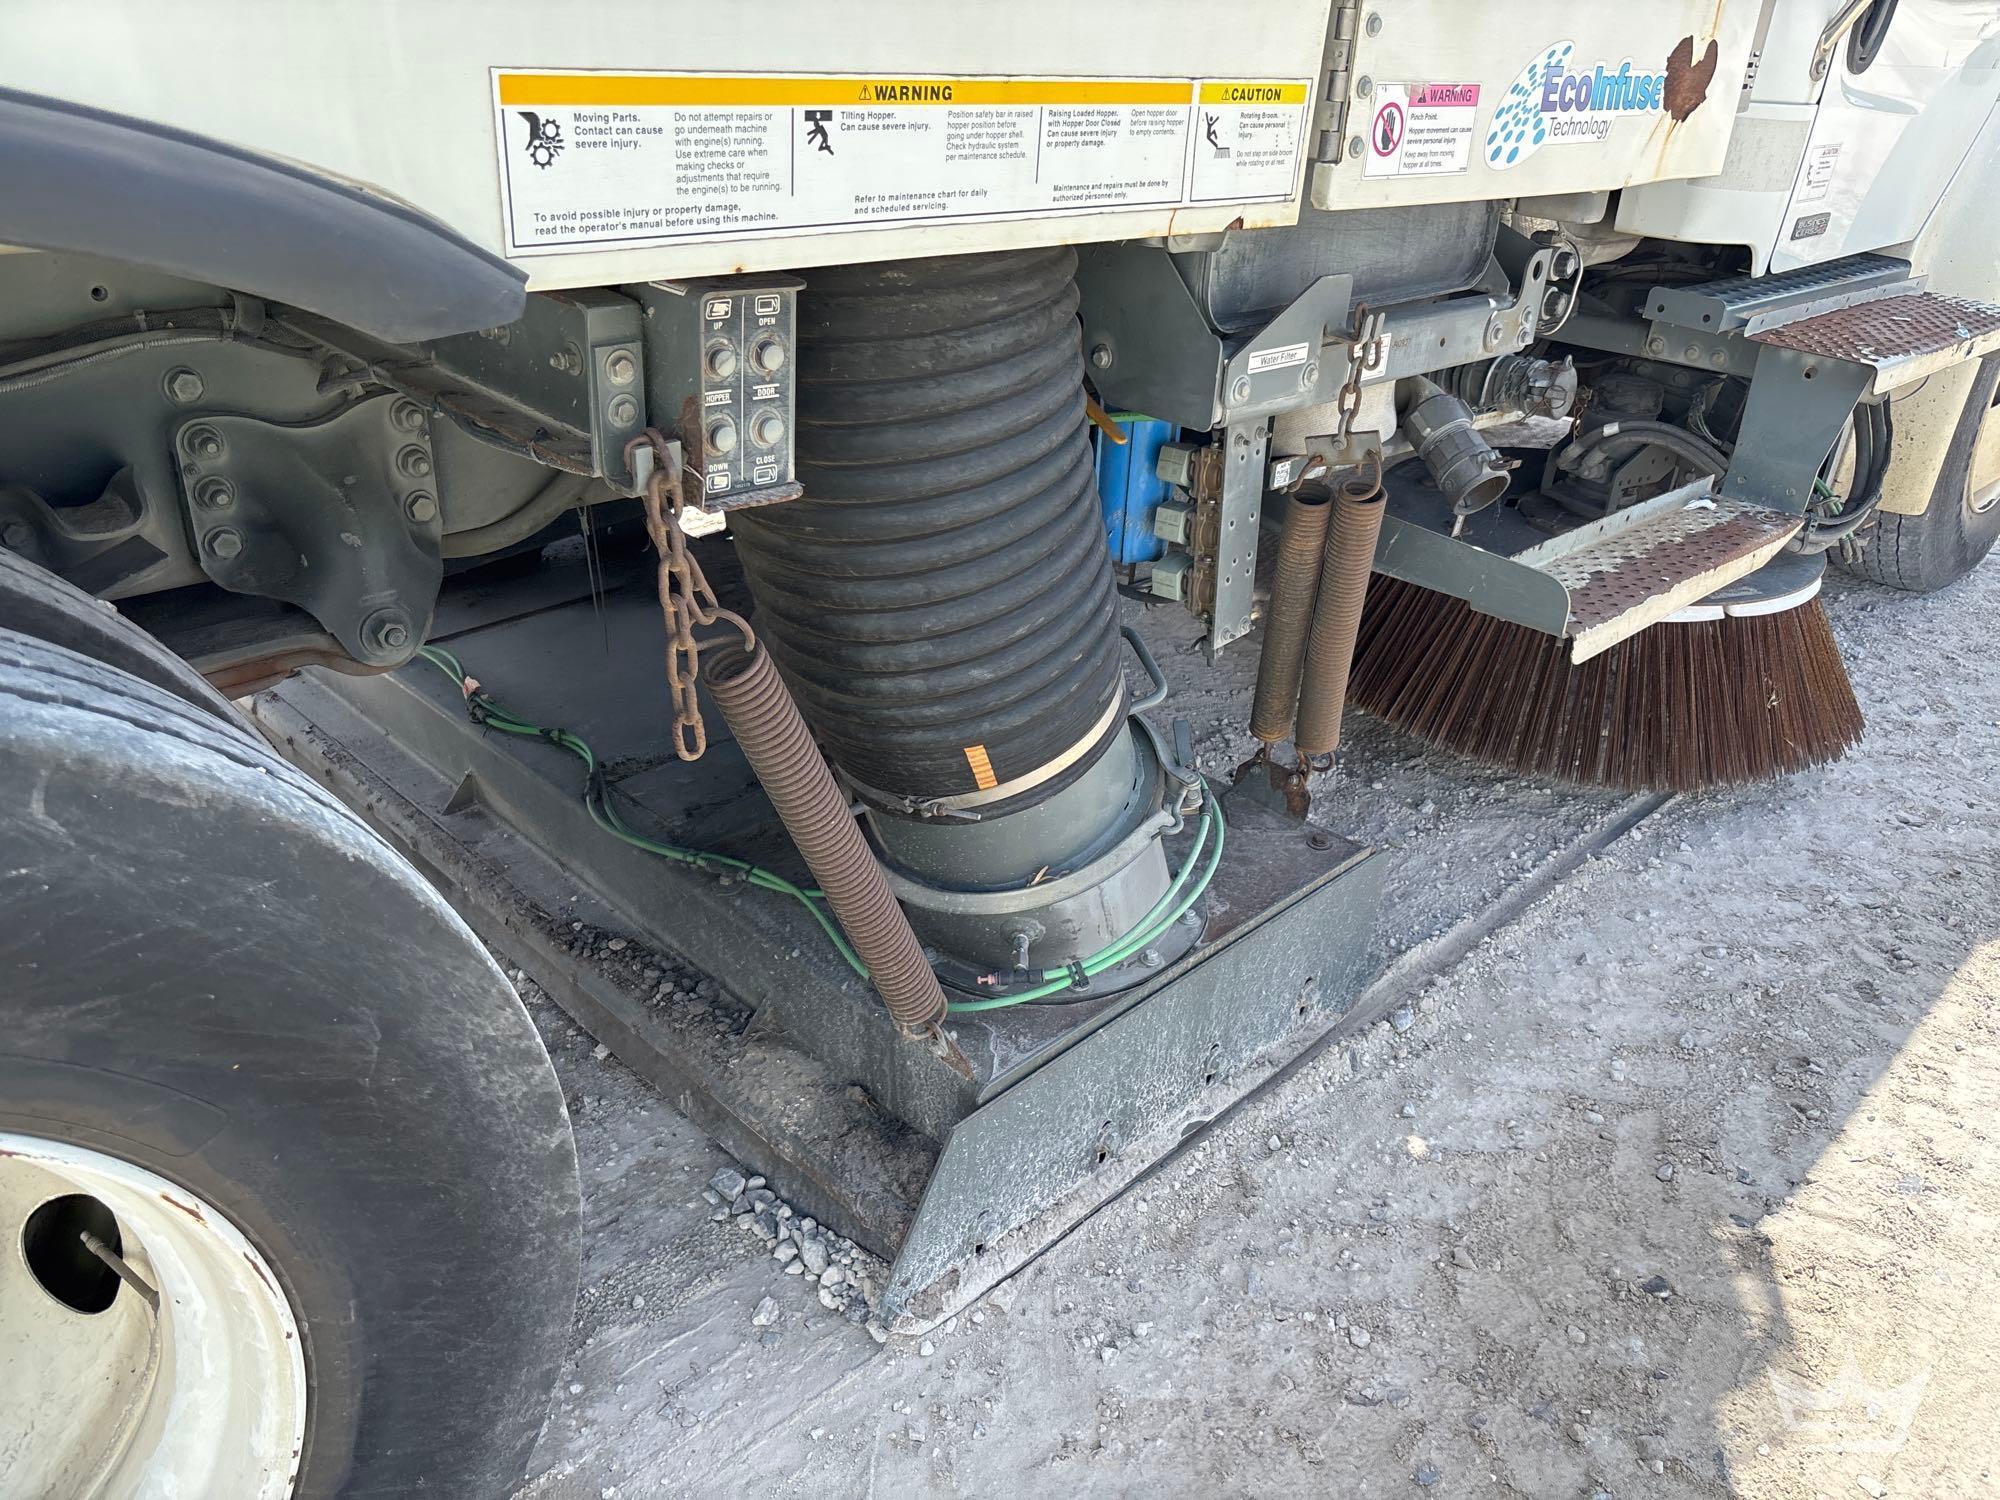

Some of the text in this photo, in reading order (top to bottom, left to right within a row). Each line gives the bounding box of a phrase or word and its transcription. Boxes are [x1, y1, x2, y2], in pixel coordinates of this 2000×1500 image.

[1540, 62, 1664, 112] EcoInfuse
[875, 86, 952, 100] WARNING
[1232, 88, 1281, 101] CAUTION
[1431, 89, 1472, 102] WARNING
[574, 113, 640, 124] Moving Parts.
[675, 113, 686, 122] Do
[689, 113, 701, 121] not
[704, 113, 733, 122] attempt
[736, 113, 762, 122] repairs
[841, 111, 896, 121] Tilting Hopper.
[975, 110, 994, 119] safety
[1049, 110, 1071, 118] Raising
[841, 123, 855, 131] Can
[908, 122, 931, 131] injury.
[947, 122, 969, 130] hopper
[971, 121, 995, 130] position
[1062, 120, 1084, 128] Hopper
[1549, 115, 1612, 139] Technology
[575, 126, 612, 135] Contact
[675, 124, 767, 136] go underneath machine
[1101, 129, 1117, 137] injury
[947, 133, 964, 141] going
[611, 139, 641, 150] injury.
[675, 137, 764, 148] with engine(s) running.
[968, 142, 996, 151] hydraulic
[1055, 139, 1079, 148] property
[1082, 139, 1105, 148] damage.
[676, 150, 691, 158] Use
[694, 150, 726, 158] extreme
[946, 154, 956, 163] per
[958, 152, 997, 160] maintenance
[676, 162, 704, 172] making
[707, 161, 734, 170] checks
[676, 172, 769, 184] adjustments that require
[677, 186, 689, 195] the
[692, 184, 728, 195] engine(s)
[752, 183, 782, 192] running.
[1104, 182, 1123, 191] repairs
[889, 193, 935, 201] maintenance
[971, 188, 988, 197] daily
[872, 204, 910, 213] scheduled
[913, 202, 948, 211] servicing.
[534, 213, 547, 222] To
[551, 211, 577, 221] avoid
[580, 209, 620, 222] possible
[624, 208, 649, 218] injury
[665, 205, 702, 216] property
[536, 226, 557, 235] read
[561, 225, 575, 234] the
[579, 222, 626, 235] operator's
[630, 219, 662, 230] manual
[666, 219, 693, 227] before
[697, 216, 720, 225] using
[741, 212, 778, 222] machine.
[759, 318, 775, 326] OPEN
[1261, 352, 1297, 365] Water Filter
[758, 387, 775, 396] DOOR
[706, 393, 730, 403] HOPPER
[756, 455, 775, 464] CLOSE
[709, 464, 728, 472] DOWN
